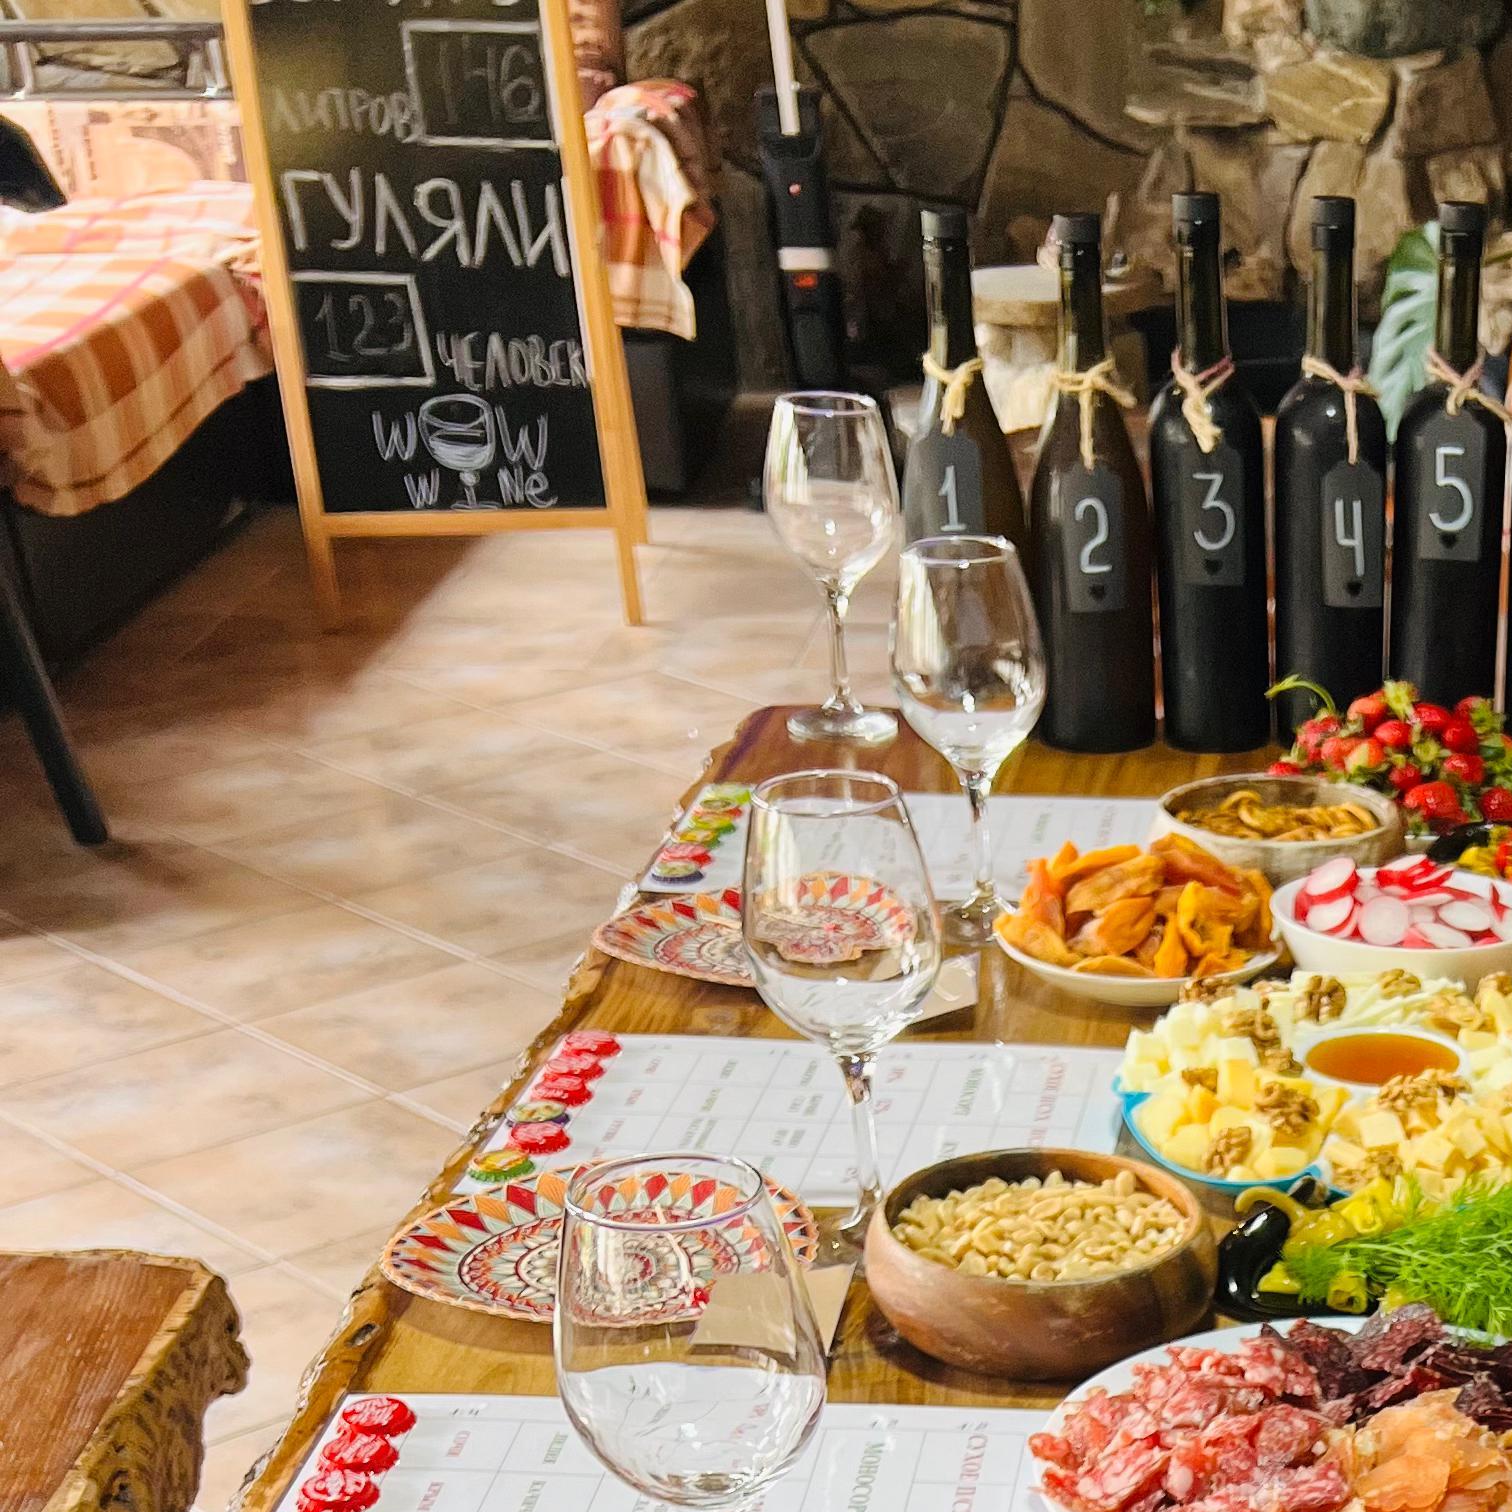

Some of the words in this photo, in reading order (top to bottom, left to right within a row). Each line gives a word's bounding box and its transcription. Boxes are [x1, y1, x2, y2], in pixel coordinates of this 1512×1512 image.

[280, 166, 570, 277] ГУЛЯЛИ
[314, 290, 414, 362] 123
[437, 330, 588, 391] ЧЕЛОВЕК
[938, 465, 967, 532] 1
[1193, 473, 1236, 550] 3
[1429, 446, 1473, 531] 5
[1075, 497, 1113, 574] 2
[1335, 498, 1364, 577] 4
